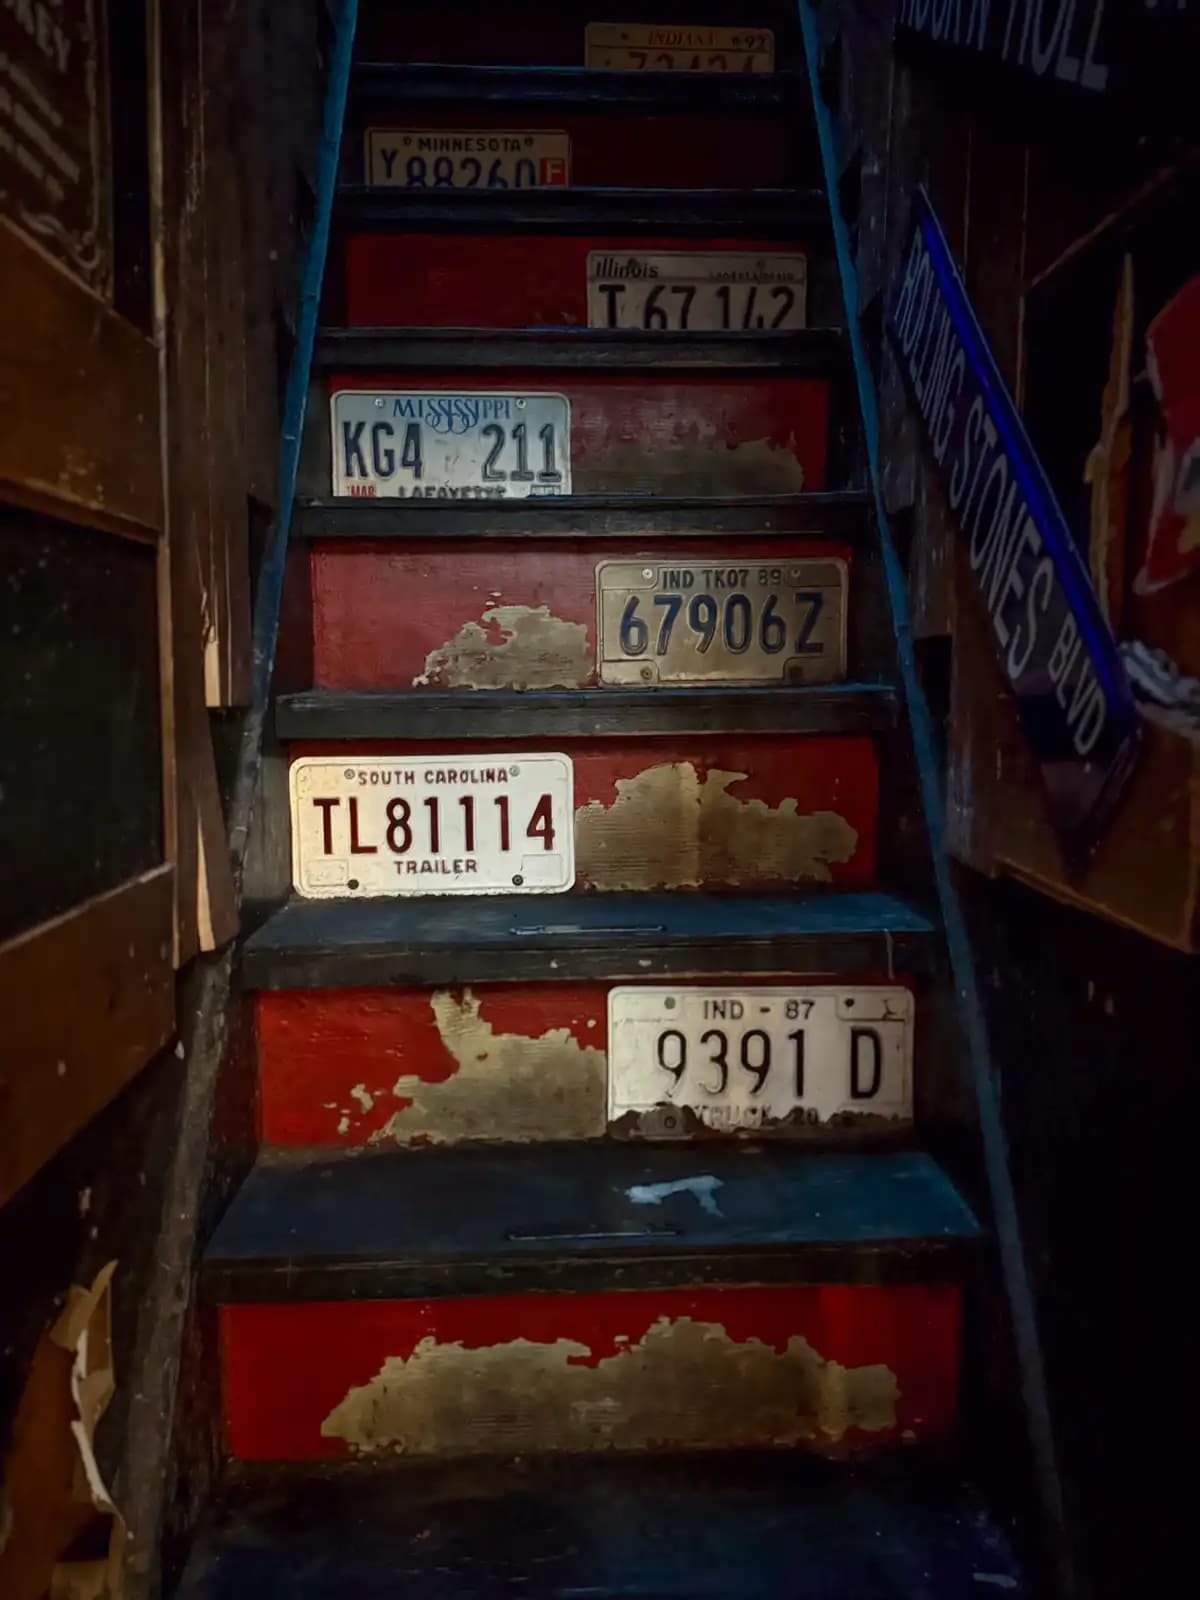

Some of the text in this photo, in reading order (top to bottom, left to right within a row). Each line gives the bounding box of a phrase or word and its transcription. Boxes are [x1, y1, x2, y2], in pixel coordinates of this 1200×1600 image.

[418, 137, 521, 152] MINNESOTA
[596, 258, 659, 279] Illinois
[393, 398, 510, 434] MISSISSIPPI
[343, 420, 562, 482] KG4 211
[896, 225, 1104, 757] ROLLING STONES BLVD
[662, 570, 694, 590] IND
[758, 570, 782, 587] 89
[358, 766, 509, 786] SOUTH CAROLINA
[312, 794, 556, 855] TL81114
[393, 859, 478, 875] TRAILER
[703, 999, 744, 1020] IND
[785, 1000, 815, 1021] 87
[656, 1026, 882, 1100] 9391 D
